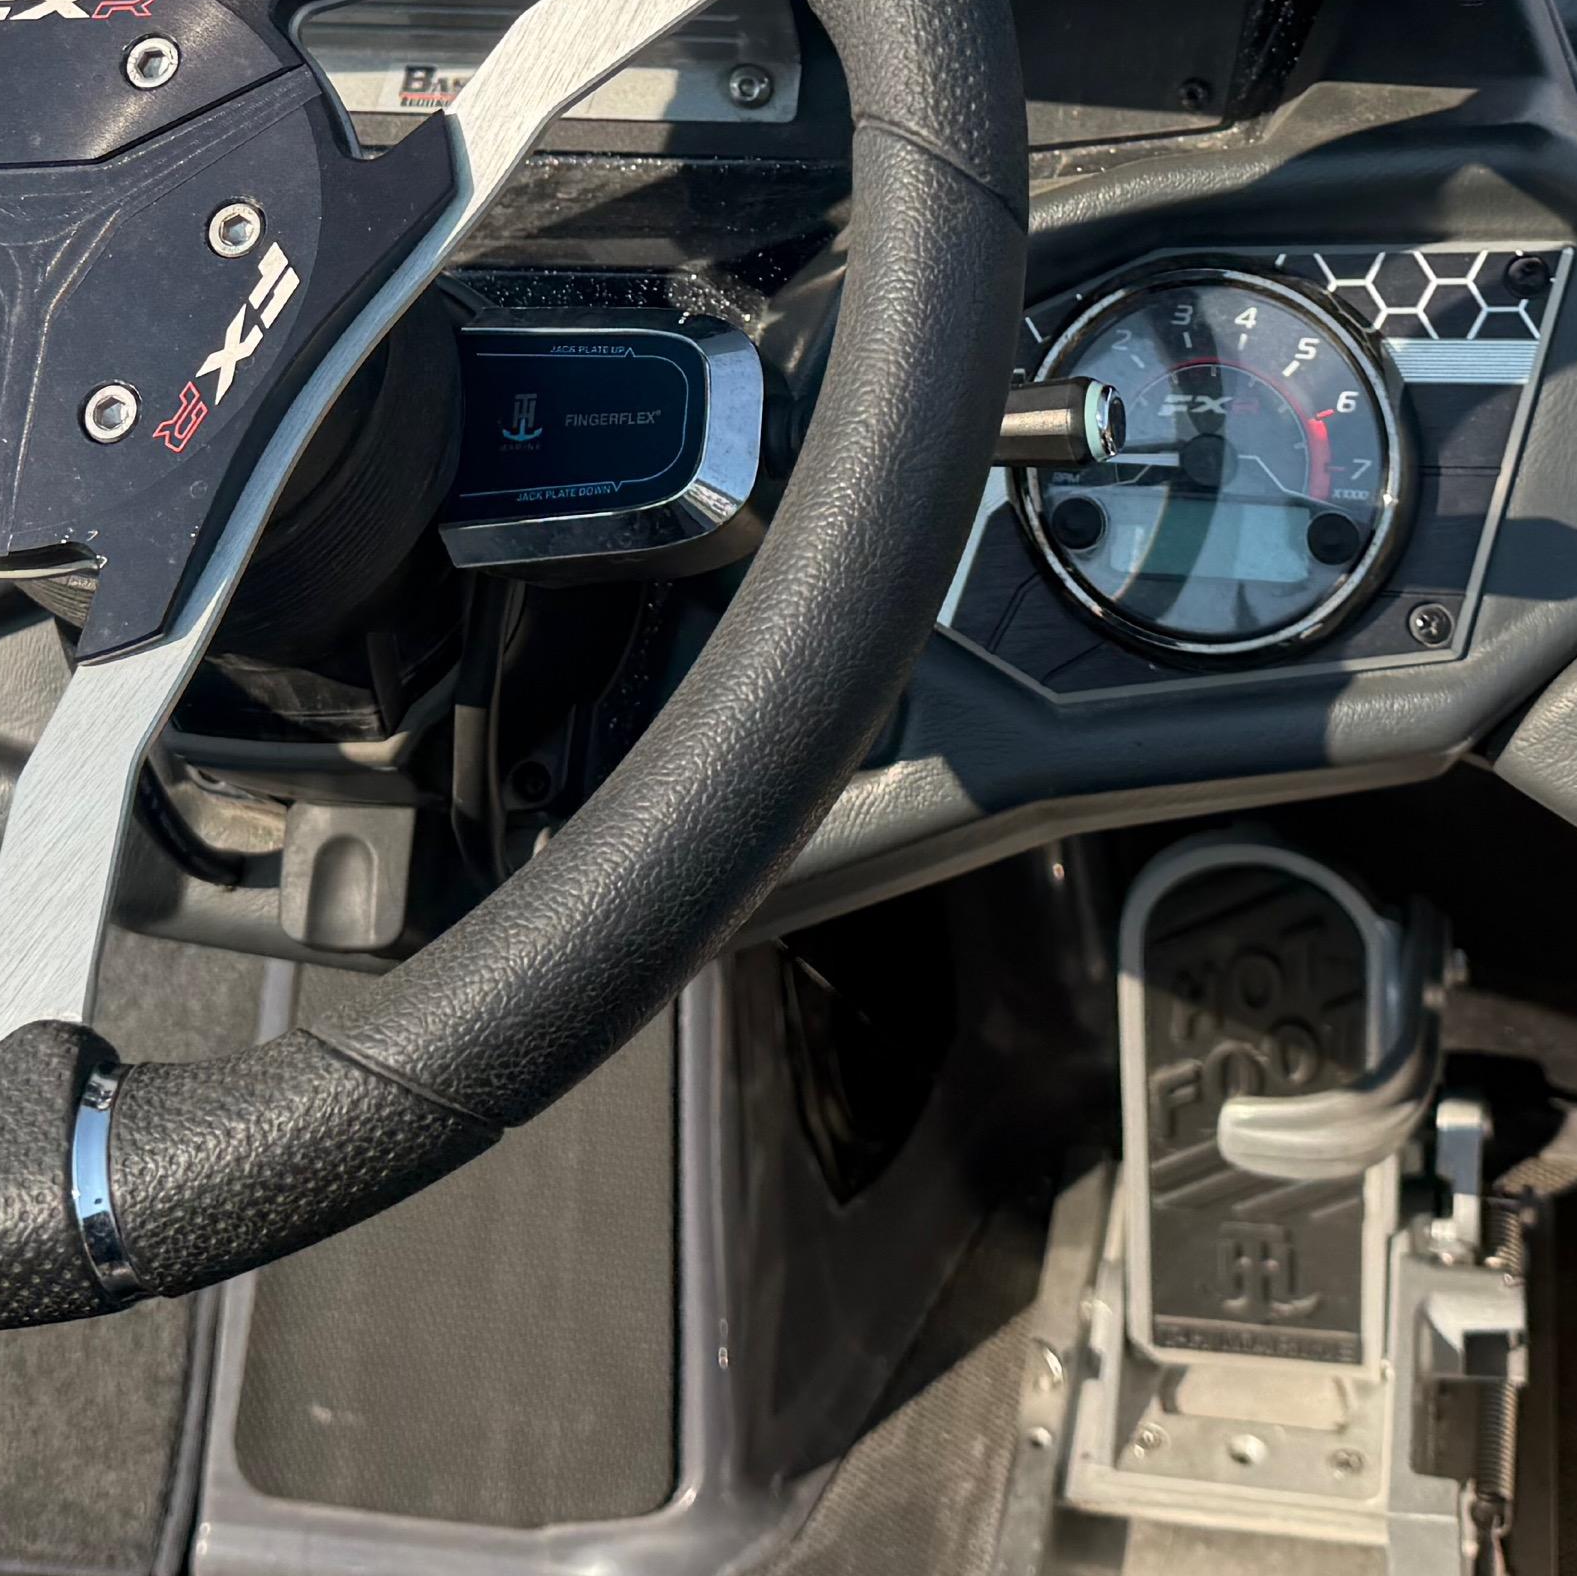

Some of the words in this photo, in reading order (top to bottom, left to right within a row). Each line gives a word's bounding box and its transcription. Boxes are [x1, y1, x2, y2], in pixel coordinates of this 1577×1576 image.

[1172, 305, 1194, 325] 3
[1234, 306, 1258, 328] 4
[153, 242, 300, 453] FXR
[550, 345, 576, 353] JACK
[578, 345, 609, 353] PLATE
[1112, 329, 1133, 350] 2
[1294, 336, 1320, 361] 5
[1336, 390, 1359, 413] 6
[1351, 459, 1372, 481] 7
[516, 491, 543, 502] JACK
[545, 488, 576, 500] PLATE
[579, 485, 611, 497] DOWN
